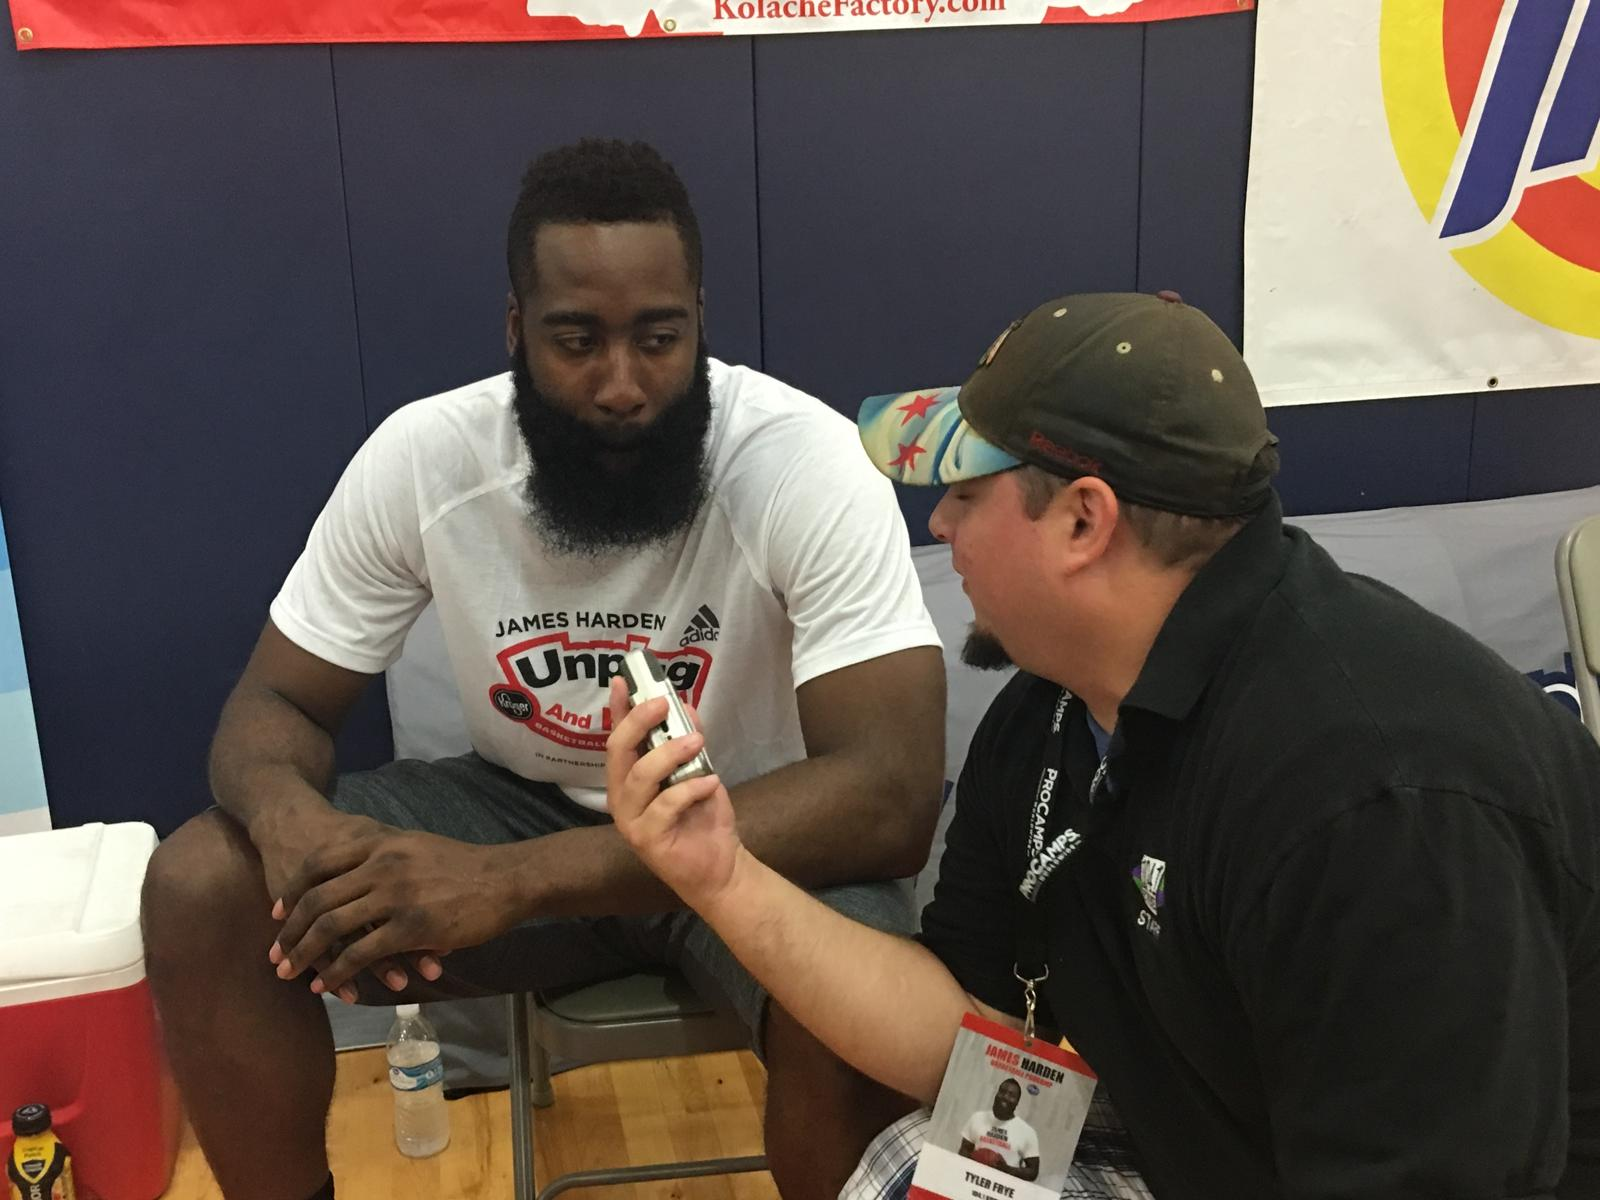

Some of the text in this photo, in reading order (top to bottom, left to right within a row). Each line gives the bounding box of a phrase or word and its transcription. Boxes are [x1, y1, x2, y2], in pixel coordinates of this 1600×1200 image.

[713, 0, 1006, 22] KolacheFactory.com
[495, 611, 666, 637] JAMES HARDEN
[515, 648, 701, 691] Unpg
[498, 692, 529, 716] Kroger
[545, 703, 593, 730] And
[985, 1044, 1021, 1066] JAMES
[1021, 1057, 1065, 1084] HARDEN
[965, 1171, 992, 1190] TYLER
[992, 1182, 1016, 1199] FRYE
